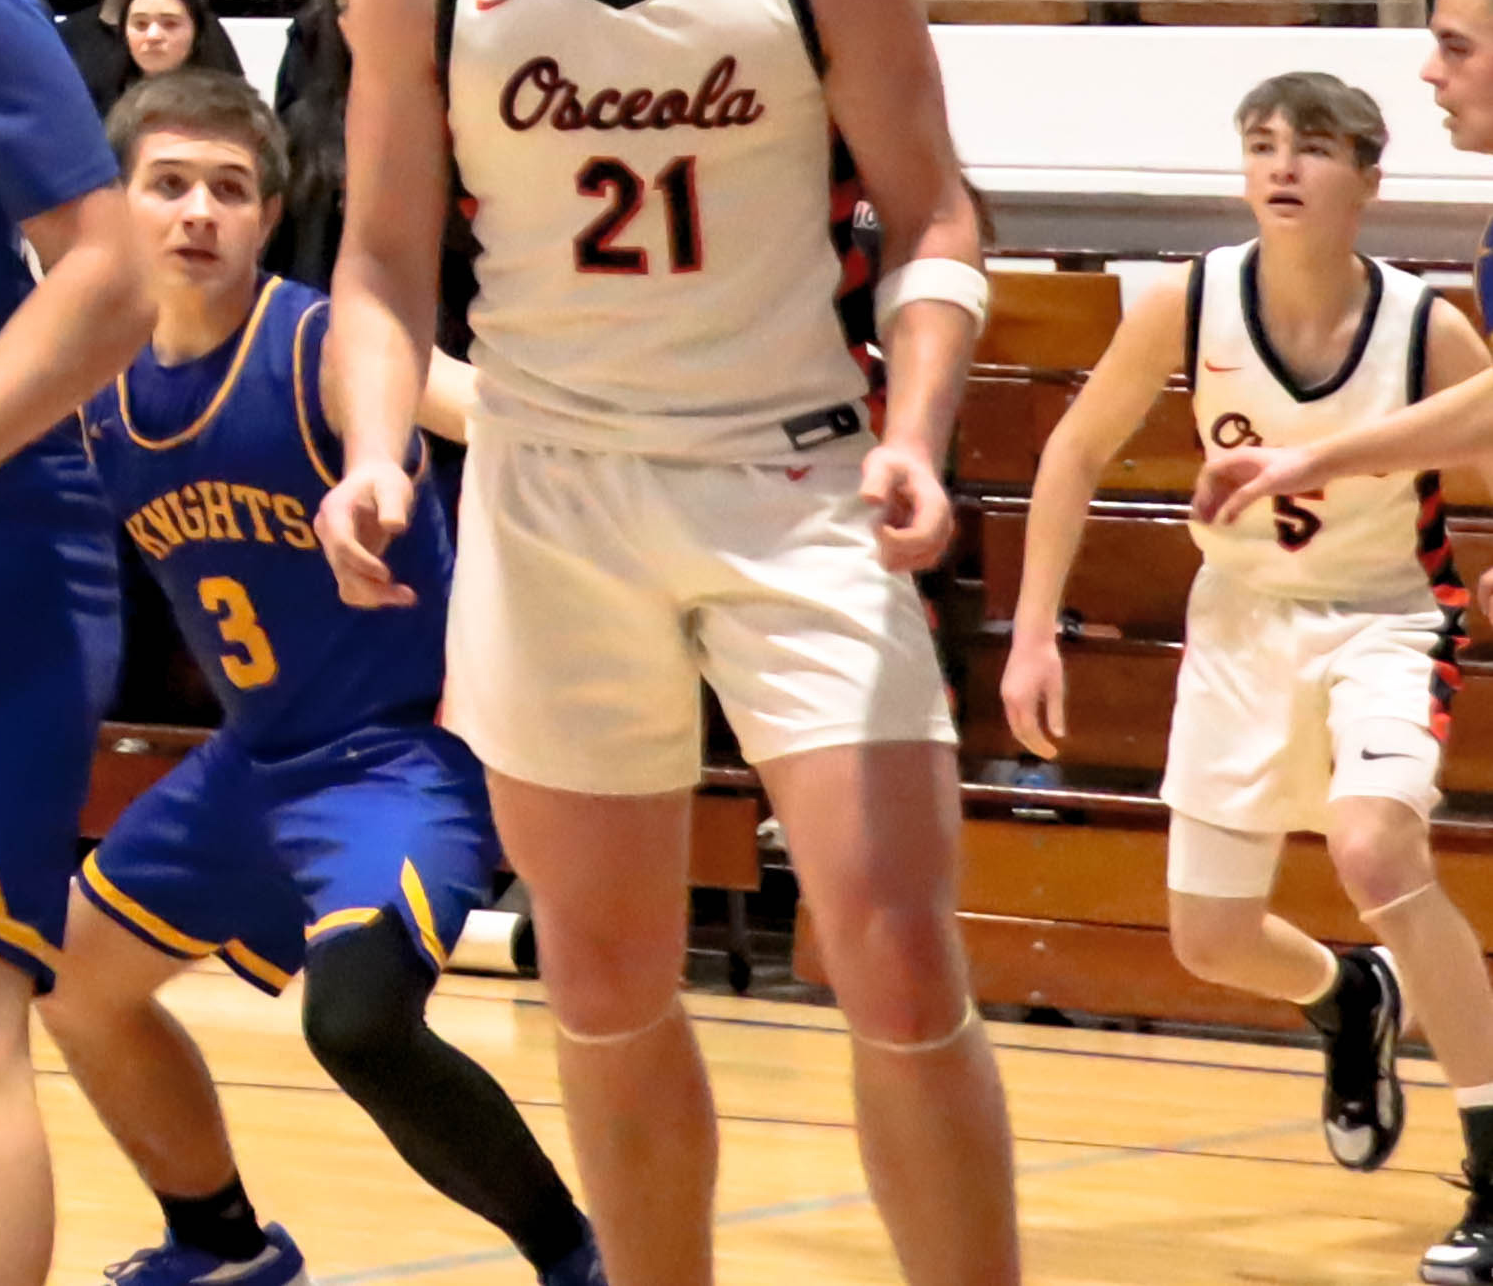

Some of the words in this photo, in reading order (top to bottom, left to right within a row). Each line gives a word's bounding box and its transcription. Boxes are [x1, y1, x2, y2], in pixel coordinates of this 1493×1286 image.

[498, 54, 765, 131] Osceola
[572, 154, 703, 275] 21
[124, 480, 320, 561] KNIGHTS
[1272, 489, 1326, 553] 5
[196, 575, 281, 690] 3
